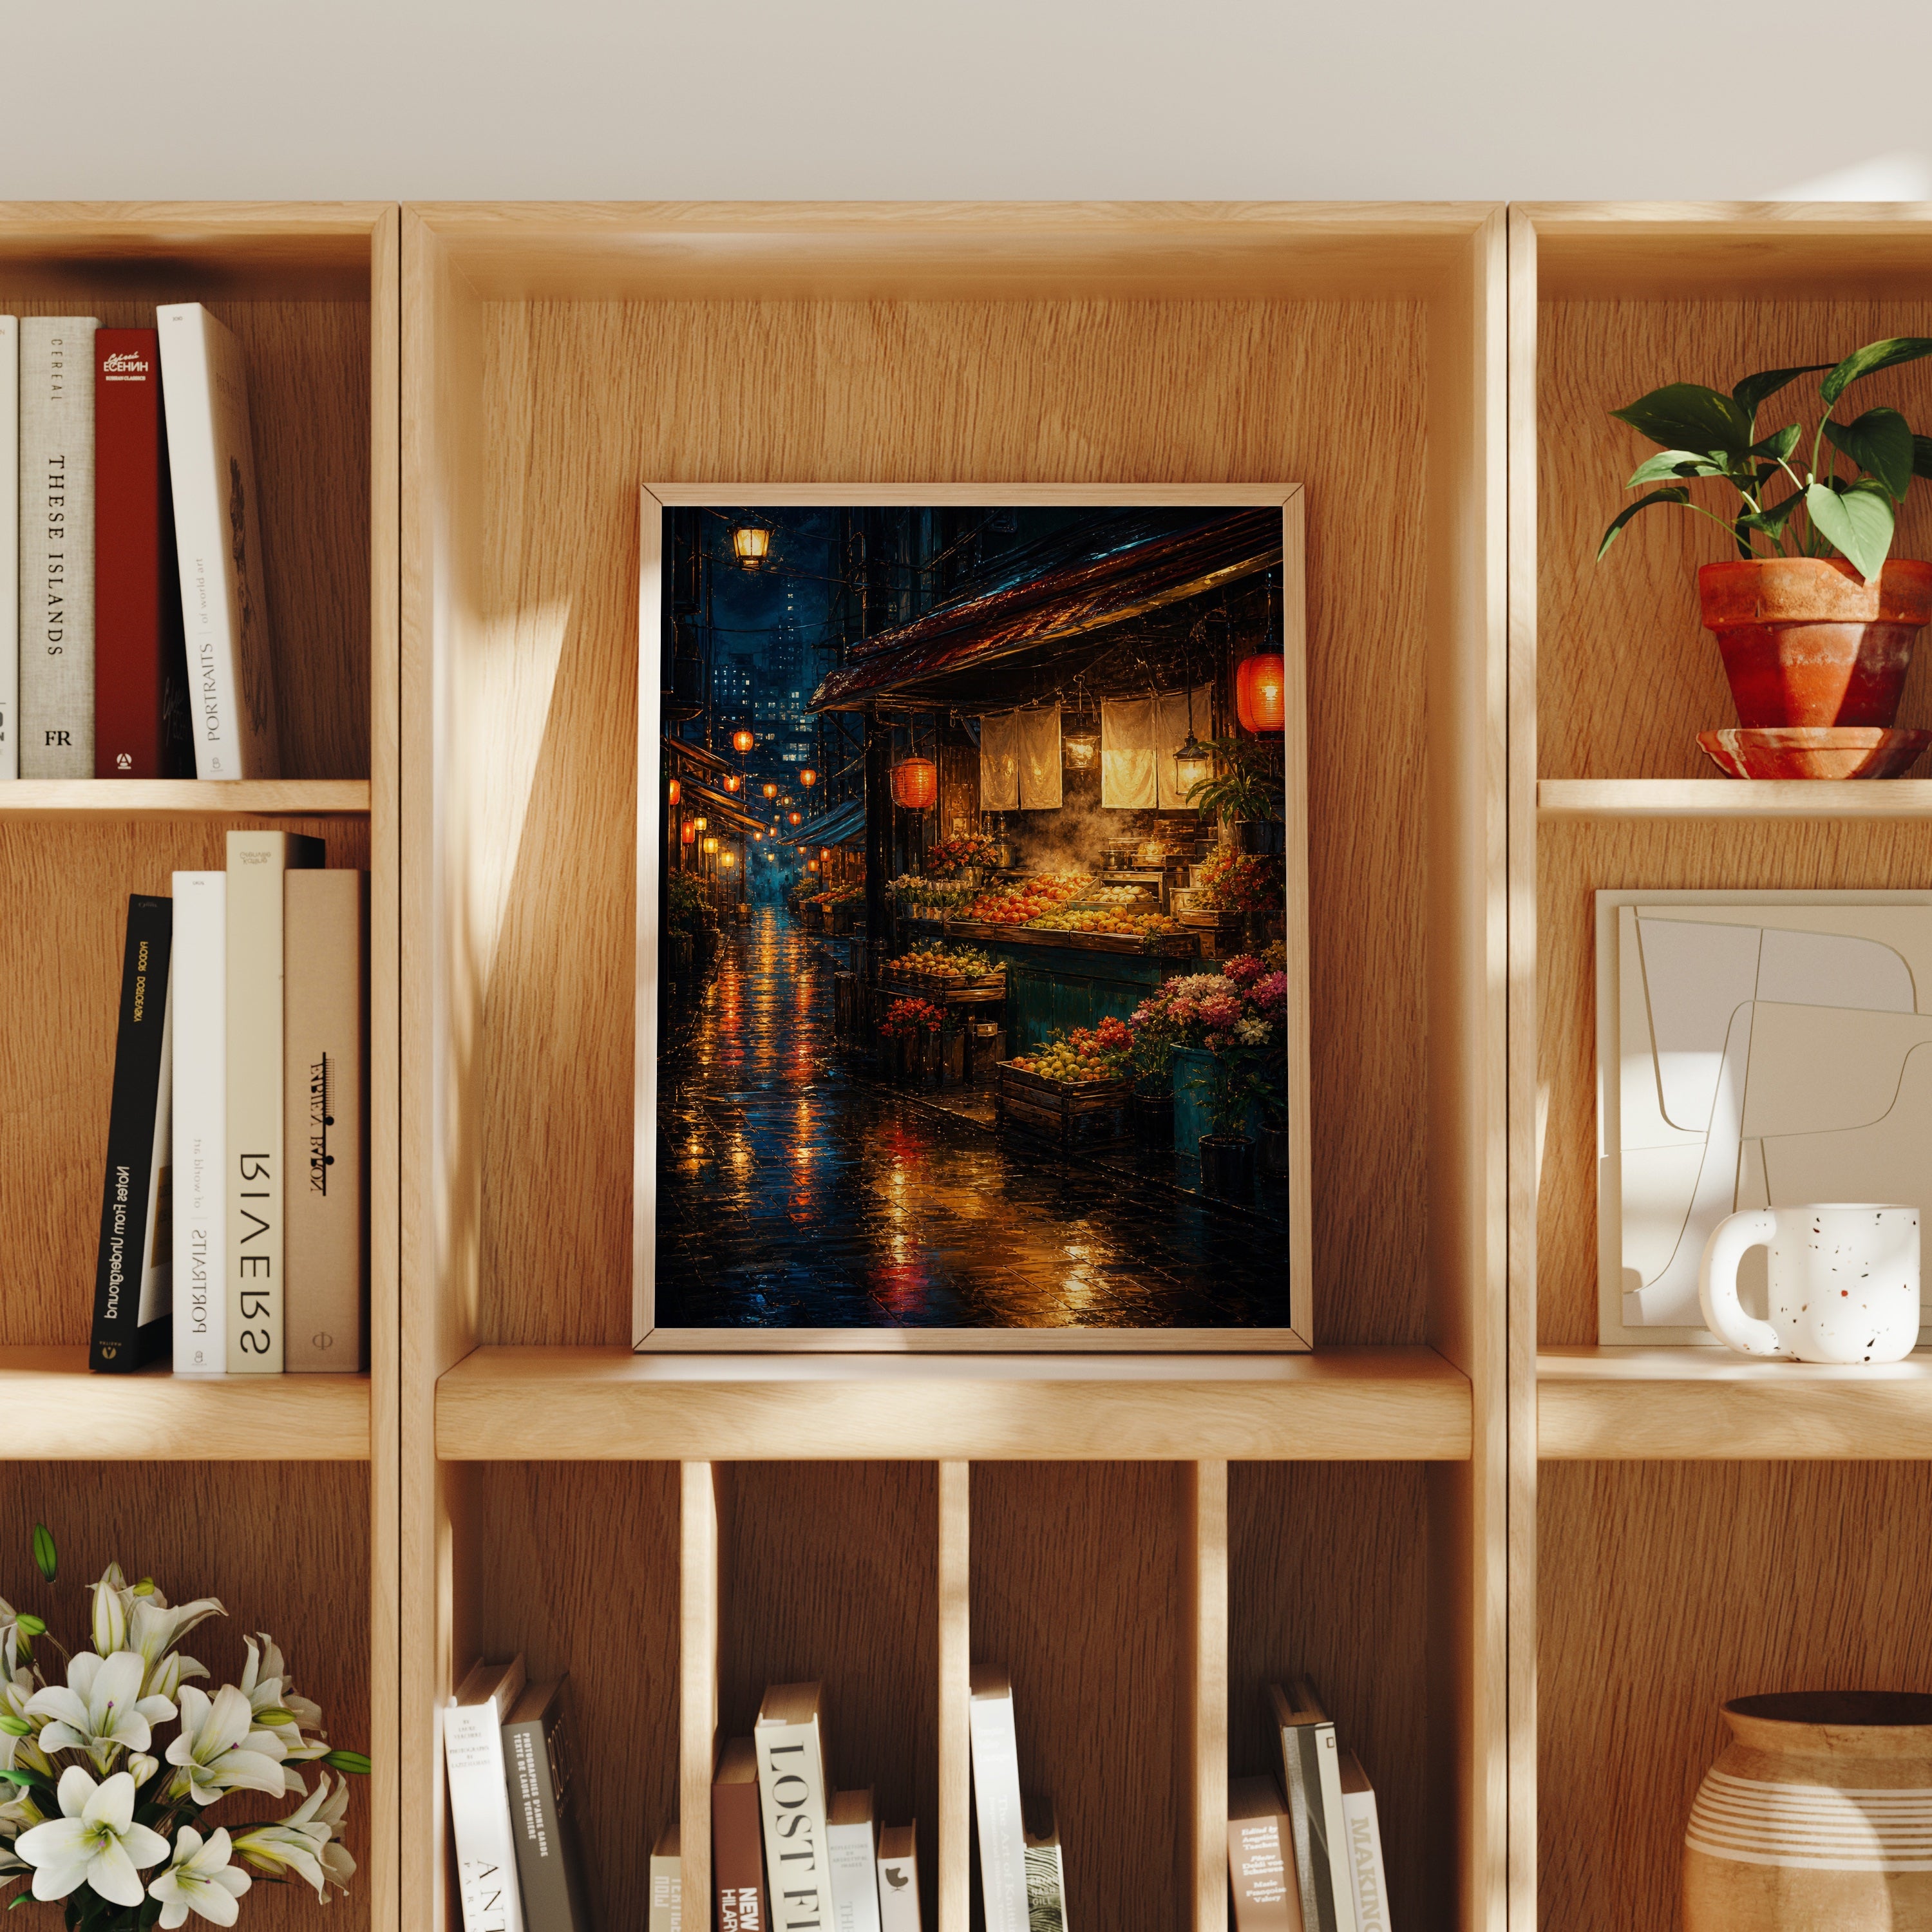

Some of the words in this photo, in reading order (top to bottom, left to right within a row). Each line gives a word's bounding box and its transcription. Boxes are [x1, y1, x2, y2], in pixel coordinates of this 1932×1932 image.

[50, 339, 63, 401] CEREAL
[103, 361, 148, 372] ЕСЕНИН
[48, 455, 65, 540] THESE
[47, 553, 64, 656] ISLANDS
[196, 577, 207, 609] world
[201, 612, 209, 624] of
[200, 643, 220, 741] PORTRAITS
[44, 730, 72, 746] FR
[513, 1733, 524, 1759] TEXTE
[517, 1760, 526, 1772] DE
[522, 1732, 540, 1797] PHOTOGRAPHIES
[519, 1774, 531, 1799] LAURE
[533, 1799, 544, 1829] D'ANNE
[768, 1741, 816, 1872] LOST
[537, 1831, 549, 1857] GARDE
[738, 1887, 760, 1931] NEW
[1032, 1896, 1052, 1906] GILL
